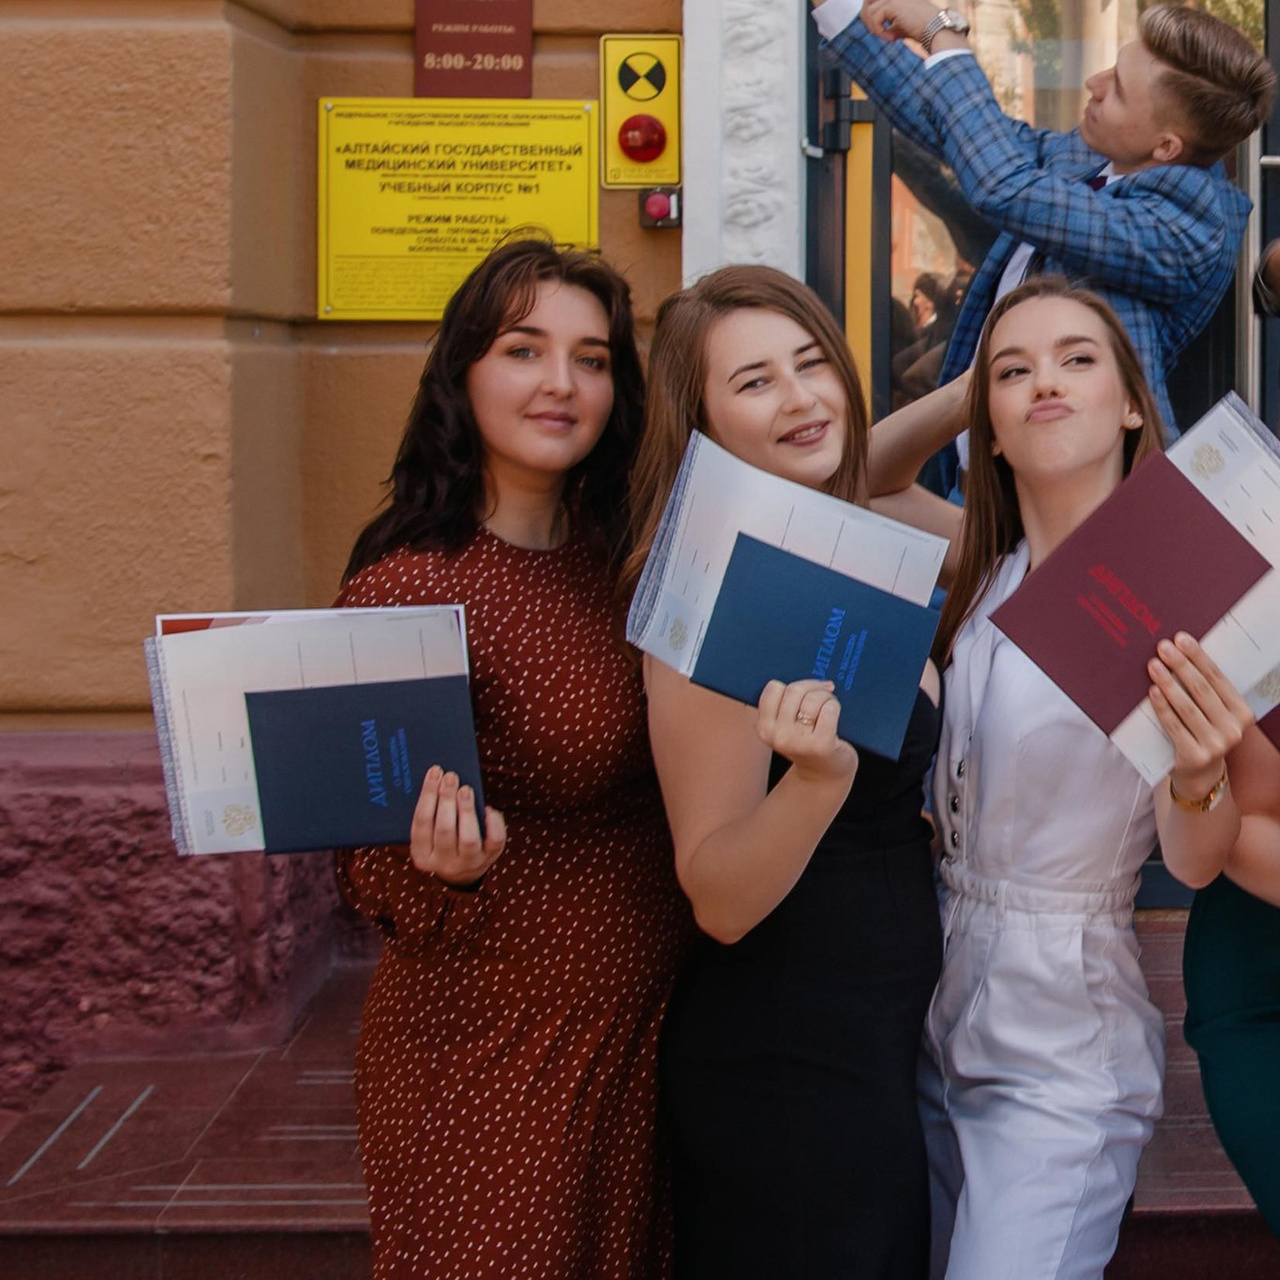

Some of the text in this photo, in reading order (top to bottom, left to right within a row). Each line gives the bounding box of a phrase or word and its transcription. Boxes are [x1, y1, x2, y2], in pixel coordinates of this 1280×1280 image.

[424, 53, 524, 71] 8:00-20:00
[435, 141, 583, 157] ГОСУДАРСТВЕННЫЙ
[345, 157, 454, 172] МЕДИЦИНСКИЙ
[378, 179, 450, 194] УЧЕБНЫЙ
[455, 182, 513, 194] КОРПУС
[812, 608, 845, 681] ИПЛОМ
[361, 719, 387, 806] ДИПЛОМ
